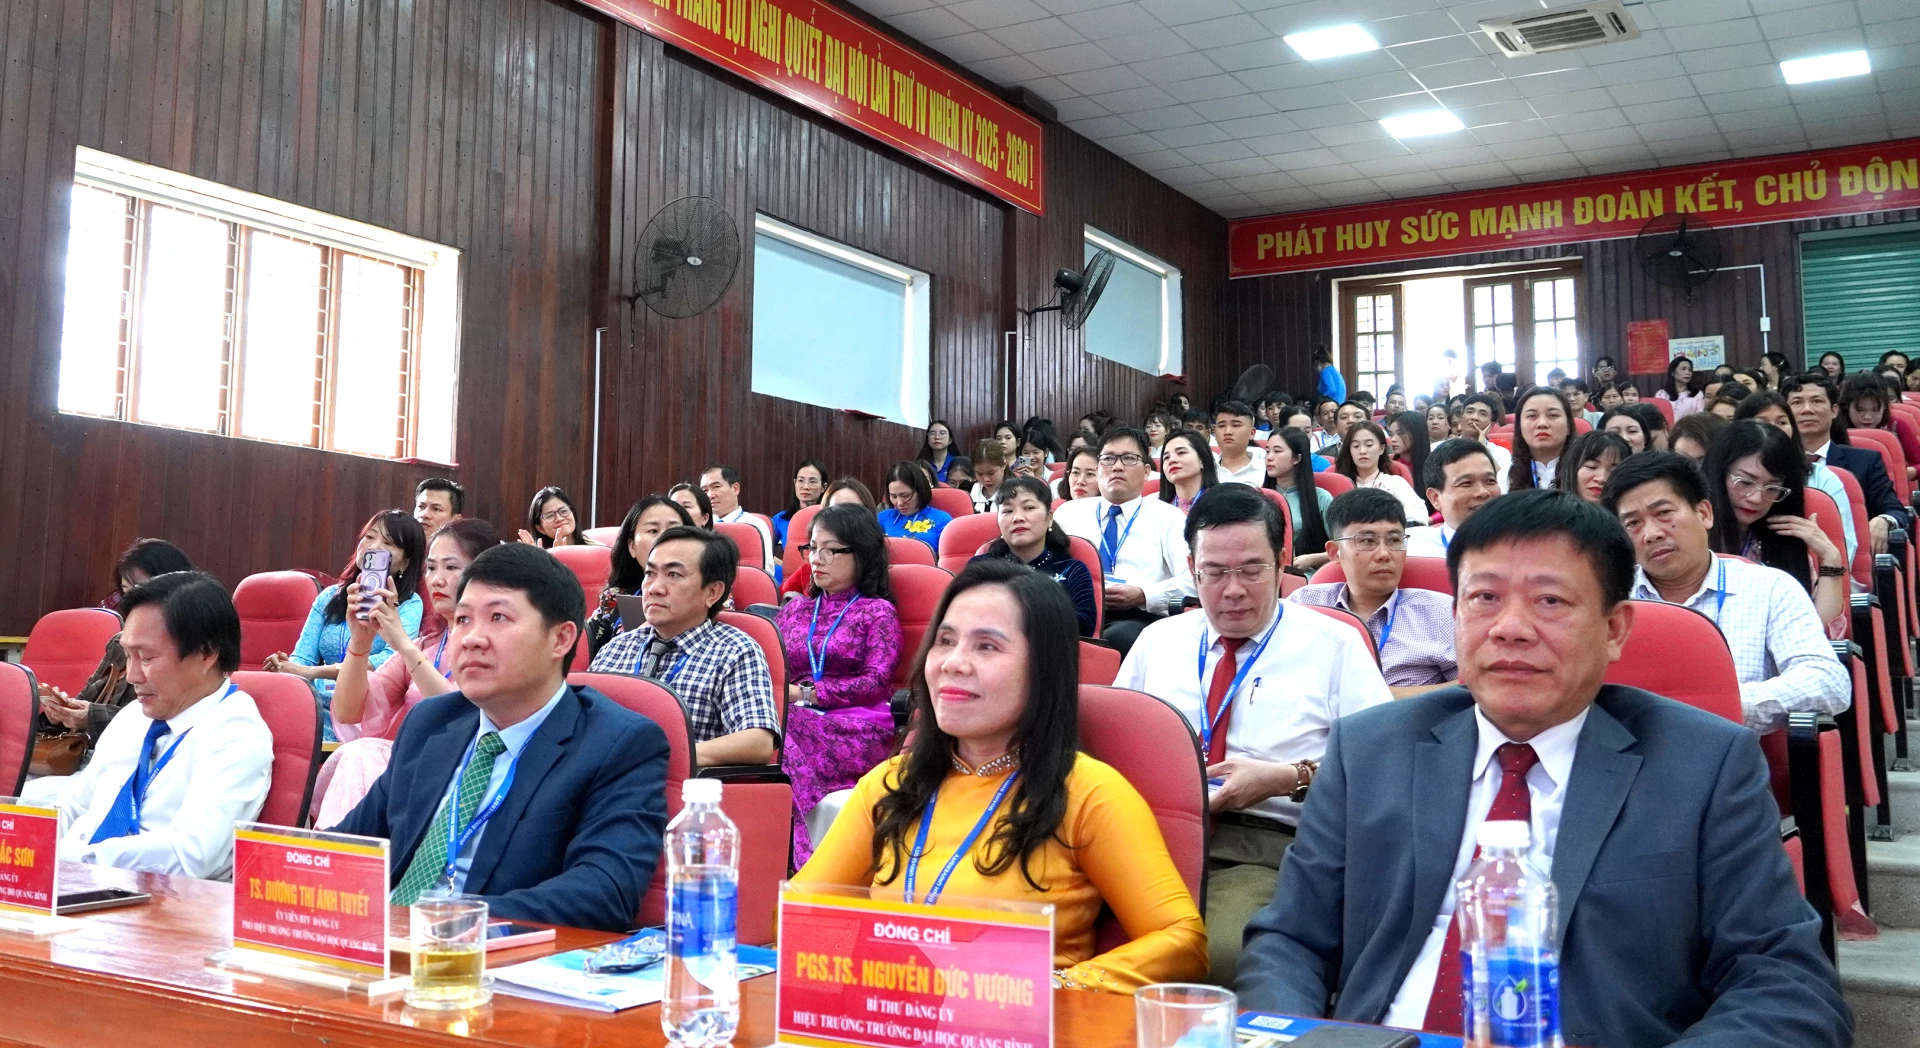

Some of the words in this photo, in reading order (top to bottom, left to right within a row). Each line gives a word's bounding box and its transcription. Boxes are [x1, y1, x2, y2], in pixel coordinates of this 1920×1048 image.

[749, 0, 782, 76] NGHỊ
[785, 8, 823, 84] QUYẾT
[825, 34, 845, 104] ĐẠI
[848, 41, 868, 114] HỘI
[871, 43, 890, 118] LẦN
[893, 70, 915, 129] THỨ
[916, 82, 927, 135] IV
[929, 89, 960, 157] NHIỆM
[962, 102, 974, 158] KỲ
[976, 114, 999, 172] 2025
[1006, 131, 1028, 187] 2030
[1257, 223, 1327, 260] PHÁT
[1336, 219, 1391, 252] HUY
[1400, 208, 1460, 244] SỨC
[1470, 199, 1563, 240] MẠNH
[1573, 185, 1663, 226] ĐOÀN
[1674, 172, 1743, 213] KẾT,
[1755, 160, 1827, 206] CHỦ
[458, 827, 473, 846] QUANG
[14, 846, 35, 868] SƠN
[286, 851, 312, 866] ĐỒNG
[313, 854, 330, 868] CHÍ
[935, 852, 960, 886] UNIVERSITY
[249, 877, 264, 900] TS.
[299, 885, 315, 913] THỊ
[317, 883, 337, 912] ÁNH
[339, 888, 369, 917] TUYẾT
[873, 921, 919, 942] ĐỒNG
[923, 927, 951, 945] CHÍ
[796, 952, 857, 986] PGS.TS.
[862, 955, 929, 994] NGUYỄN
[933, 964, 969, 999] ĐỨC
[973, 972, 1034, 1009] VƯỢNG
[866, 995, 878, 1012] BÍ
[880, 999, 904, 1015] THƯ
[905, 1000, 937, 1020] ĐẢNG
[793, 1010, 818, 1029] HIỆU
[820, 1014, 865, 1033] TRƯỞNG
[866, 1020, 911, 1040] TRƯỜNG
[913, 1027, 933, 1046] ĐẠI
[934, 1030, 960, 1048] HỌC
